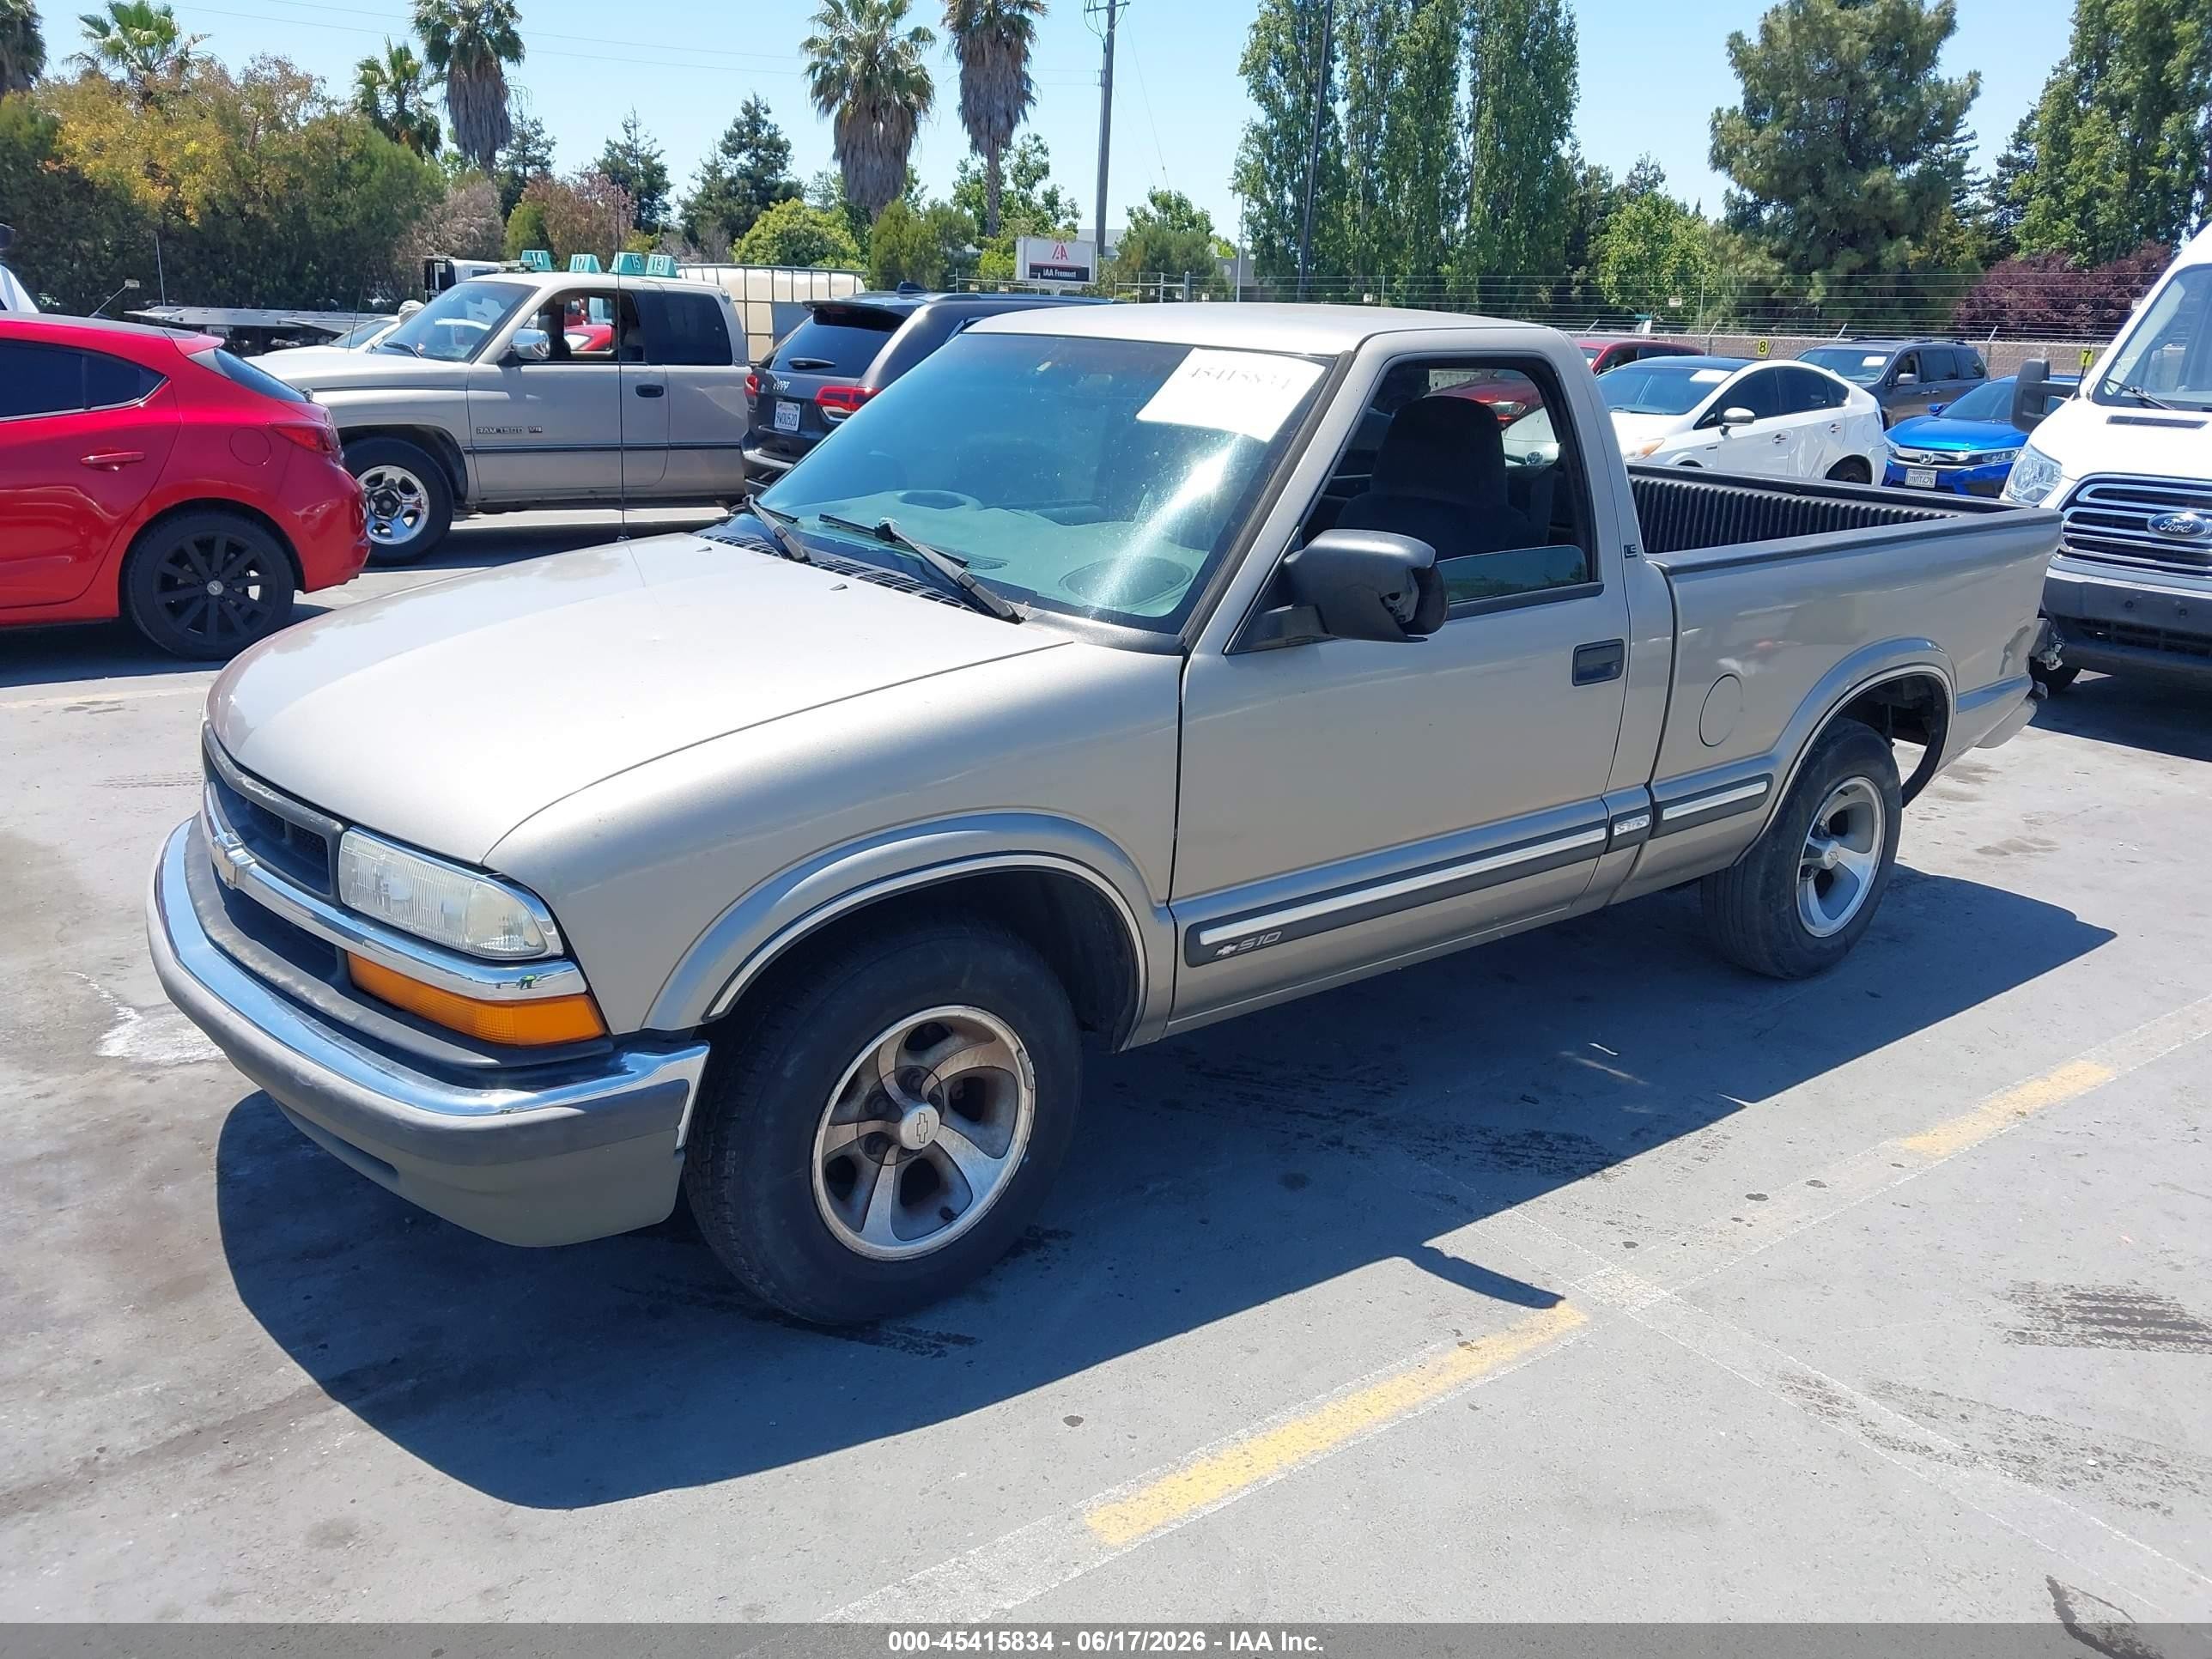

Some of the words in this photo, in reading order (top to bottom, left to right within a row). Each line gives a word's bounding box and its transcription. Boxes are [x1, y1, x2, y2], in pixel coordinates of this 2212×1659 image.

[531, 252, 544, 266] 14
[574, 256, 585, 270] 17
[631, 255, 641, 269] 15
[653, 257, 665, 270] 13
[1759, 341, 1766, 353] 8
[2083, 350, 2092, 364] 7
[2159, 518, 2193, 533] Ford
[1238, 931, 1282, 951] S10
